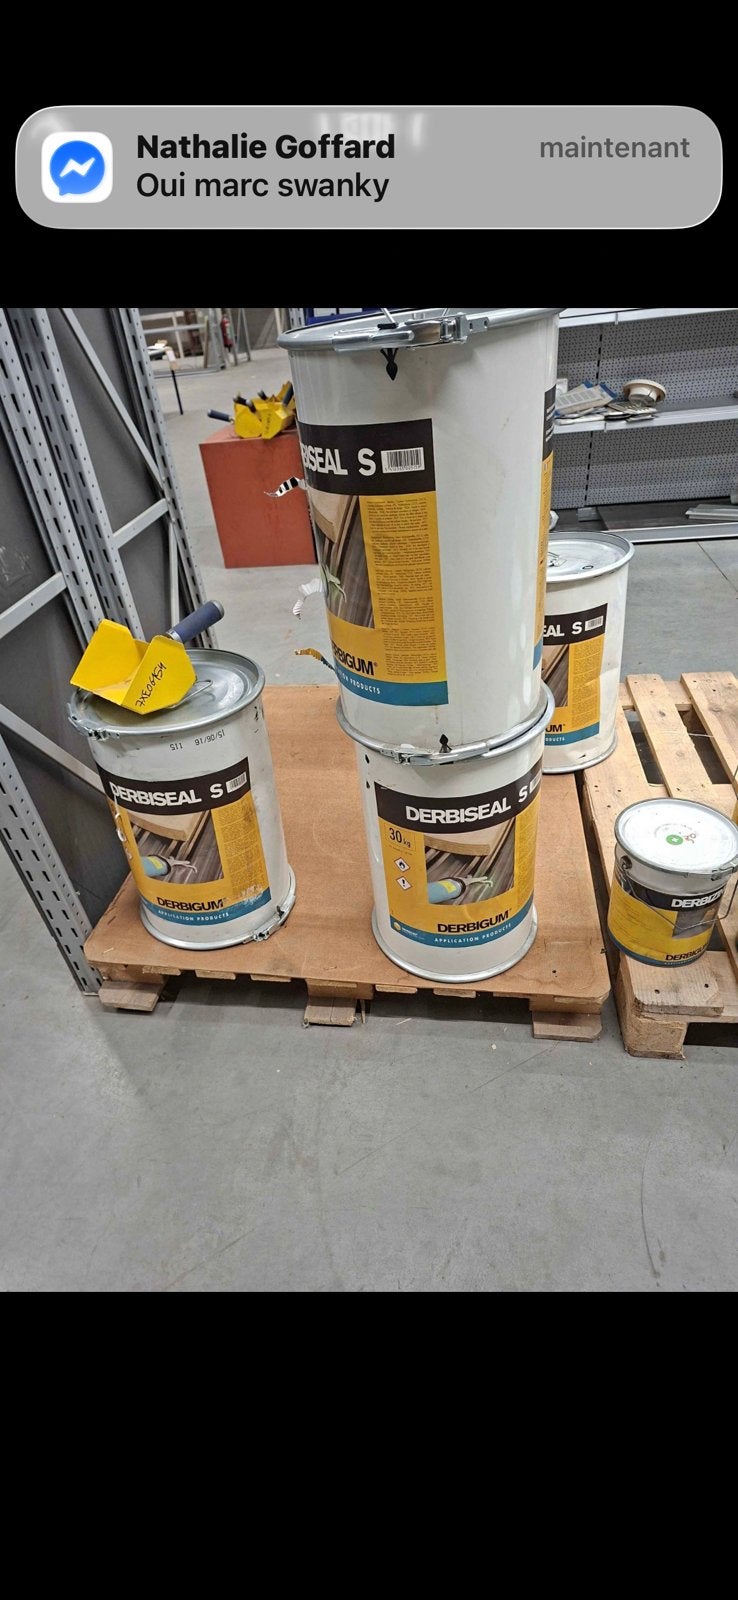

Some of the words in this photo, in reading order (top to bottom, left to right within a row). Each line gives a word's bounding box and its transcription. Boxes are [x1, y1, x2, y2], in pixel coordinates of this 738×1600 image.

[357, 447, 376, 476] S
[571, 621, 583, 635] S
[194, 729, 226, 746] 15/06/16
[169, 743, 184, 751] 115
[109, 781, 202, 806] DERBISEAL
[209, 783, 224, 799] S
[405, 797, 511, 824] DERBISEAL
[518, 785, 528, 803] S
[389, 827, 403, 843] 30
[156, 897, 224, 911] DERBIGUM
[437, 910, 509, 933] DERBIGUM
[482, 923, 512, 940] PRODUCTS
